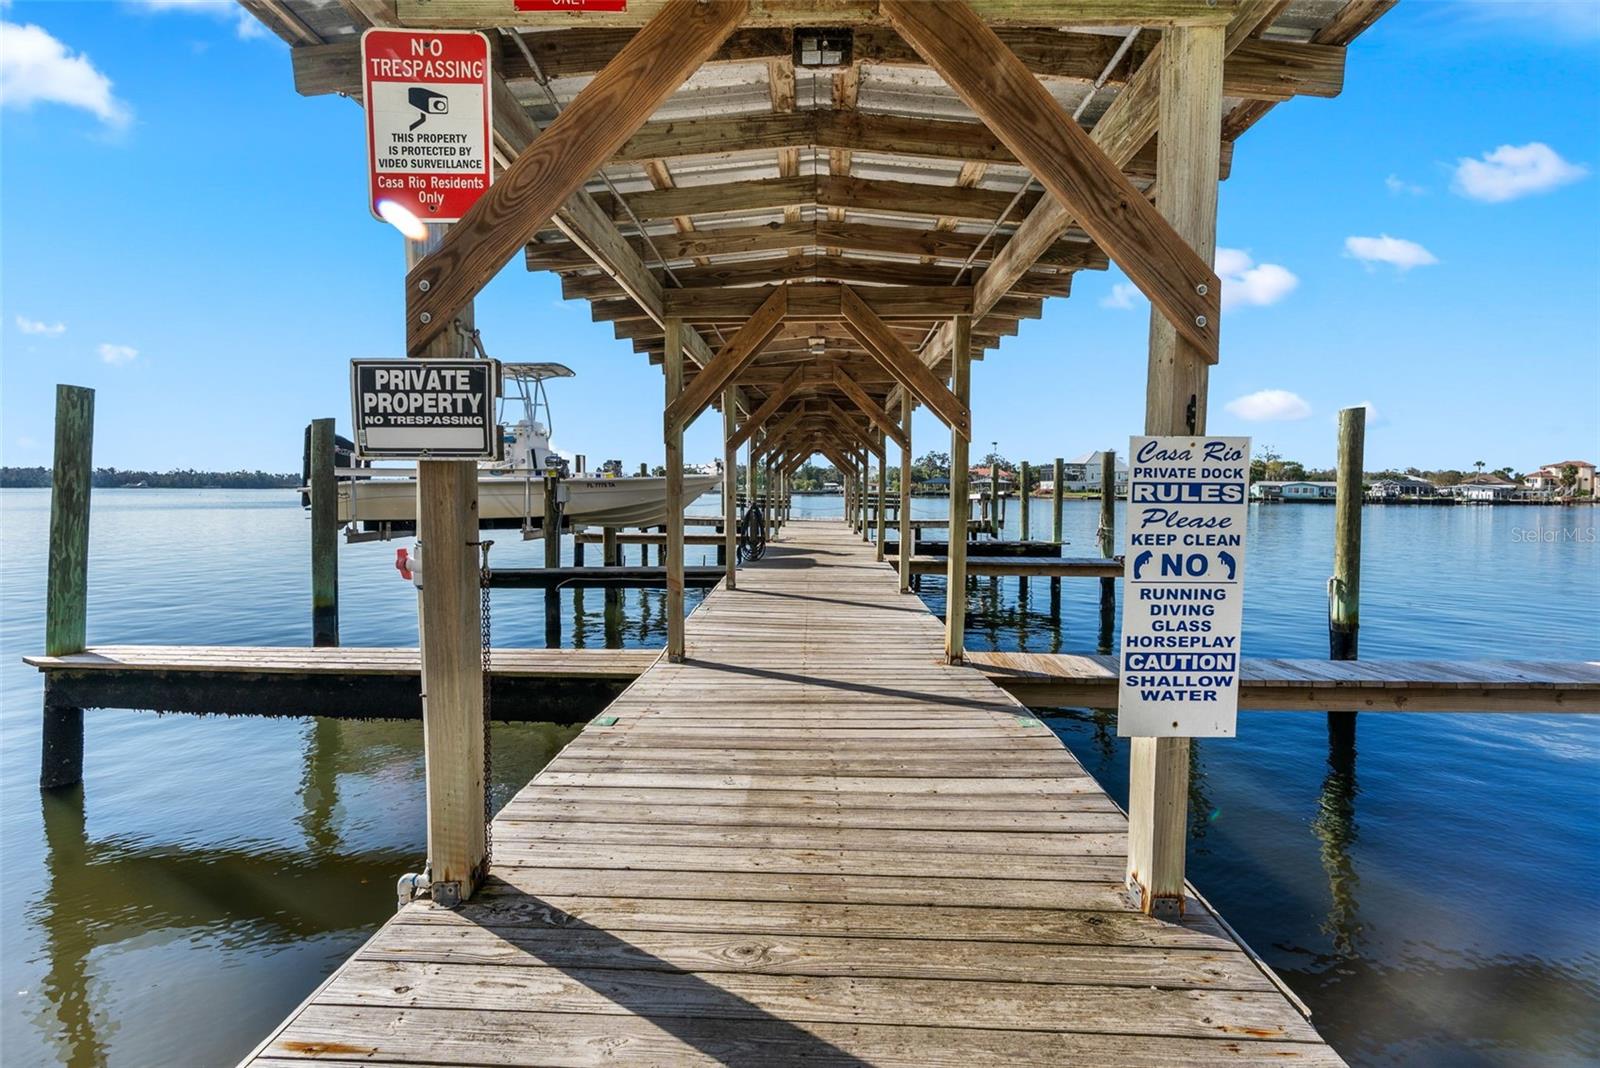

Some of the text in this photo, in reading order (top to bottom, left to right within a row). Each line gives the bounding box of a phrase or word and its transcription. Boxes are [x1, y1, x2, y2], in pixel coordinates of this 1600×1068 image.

[411, 38, 443, 56] NO
[371, 58, 483, 79] TRESPASSING
[392, 133, 468, 144] THIS PROPERTY
[388, 146, 472, 156] IS PROTECTED BY
[378, 159, 482, 169] VIDEO SURVEILLANCE
[378, 176, 484, 189] Casa Rio Residents
[418, 191, 444, 205] Only
[375, 370, 470, 390] PRIVATE
[364, 392, 482, 414] PROPERTY
[365, 416, 483, 425] NO TRESPASSING
[1136, 440, 1192, 464] Casa
[1134, 468, 1244, 479] PRIVATE DOCK
[1134, 484, 1243, 502] RULES
[1140, 508, 1232, 528] Please
[1132, 534, 1240, 546] KEEP CLEAN
[1161, 554, 1208, 577] NO
[1140, 589, 1226, 600] RUNNING
[1150, 604, 1215, 616] DIVING
[1152, 620, 1212, 632] GLASS
[1126, 636, 1236, 648] HORSEPLAY
[1128, 654, 1232, 670] CAUTION
[1126, 676, 1233, 687] SHALLOW
[1140, 690, 1217, 701] WATER
